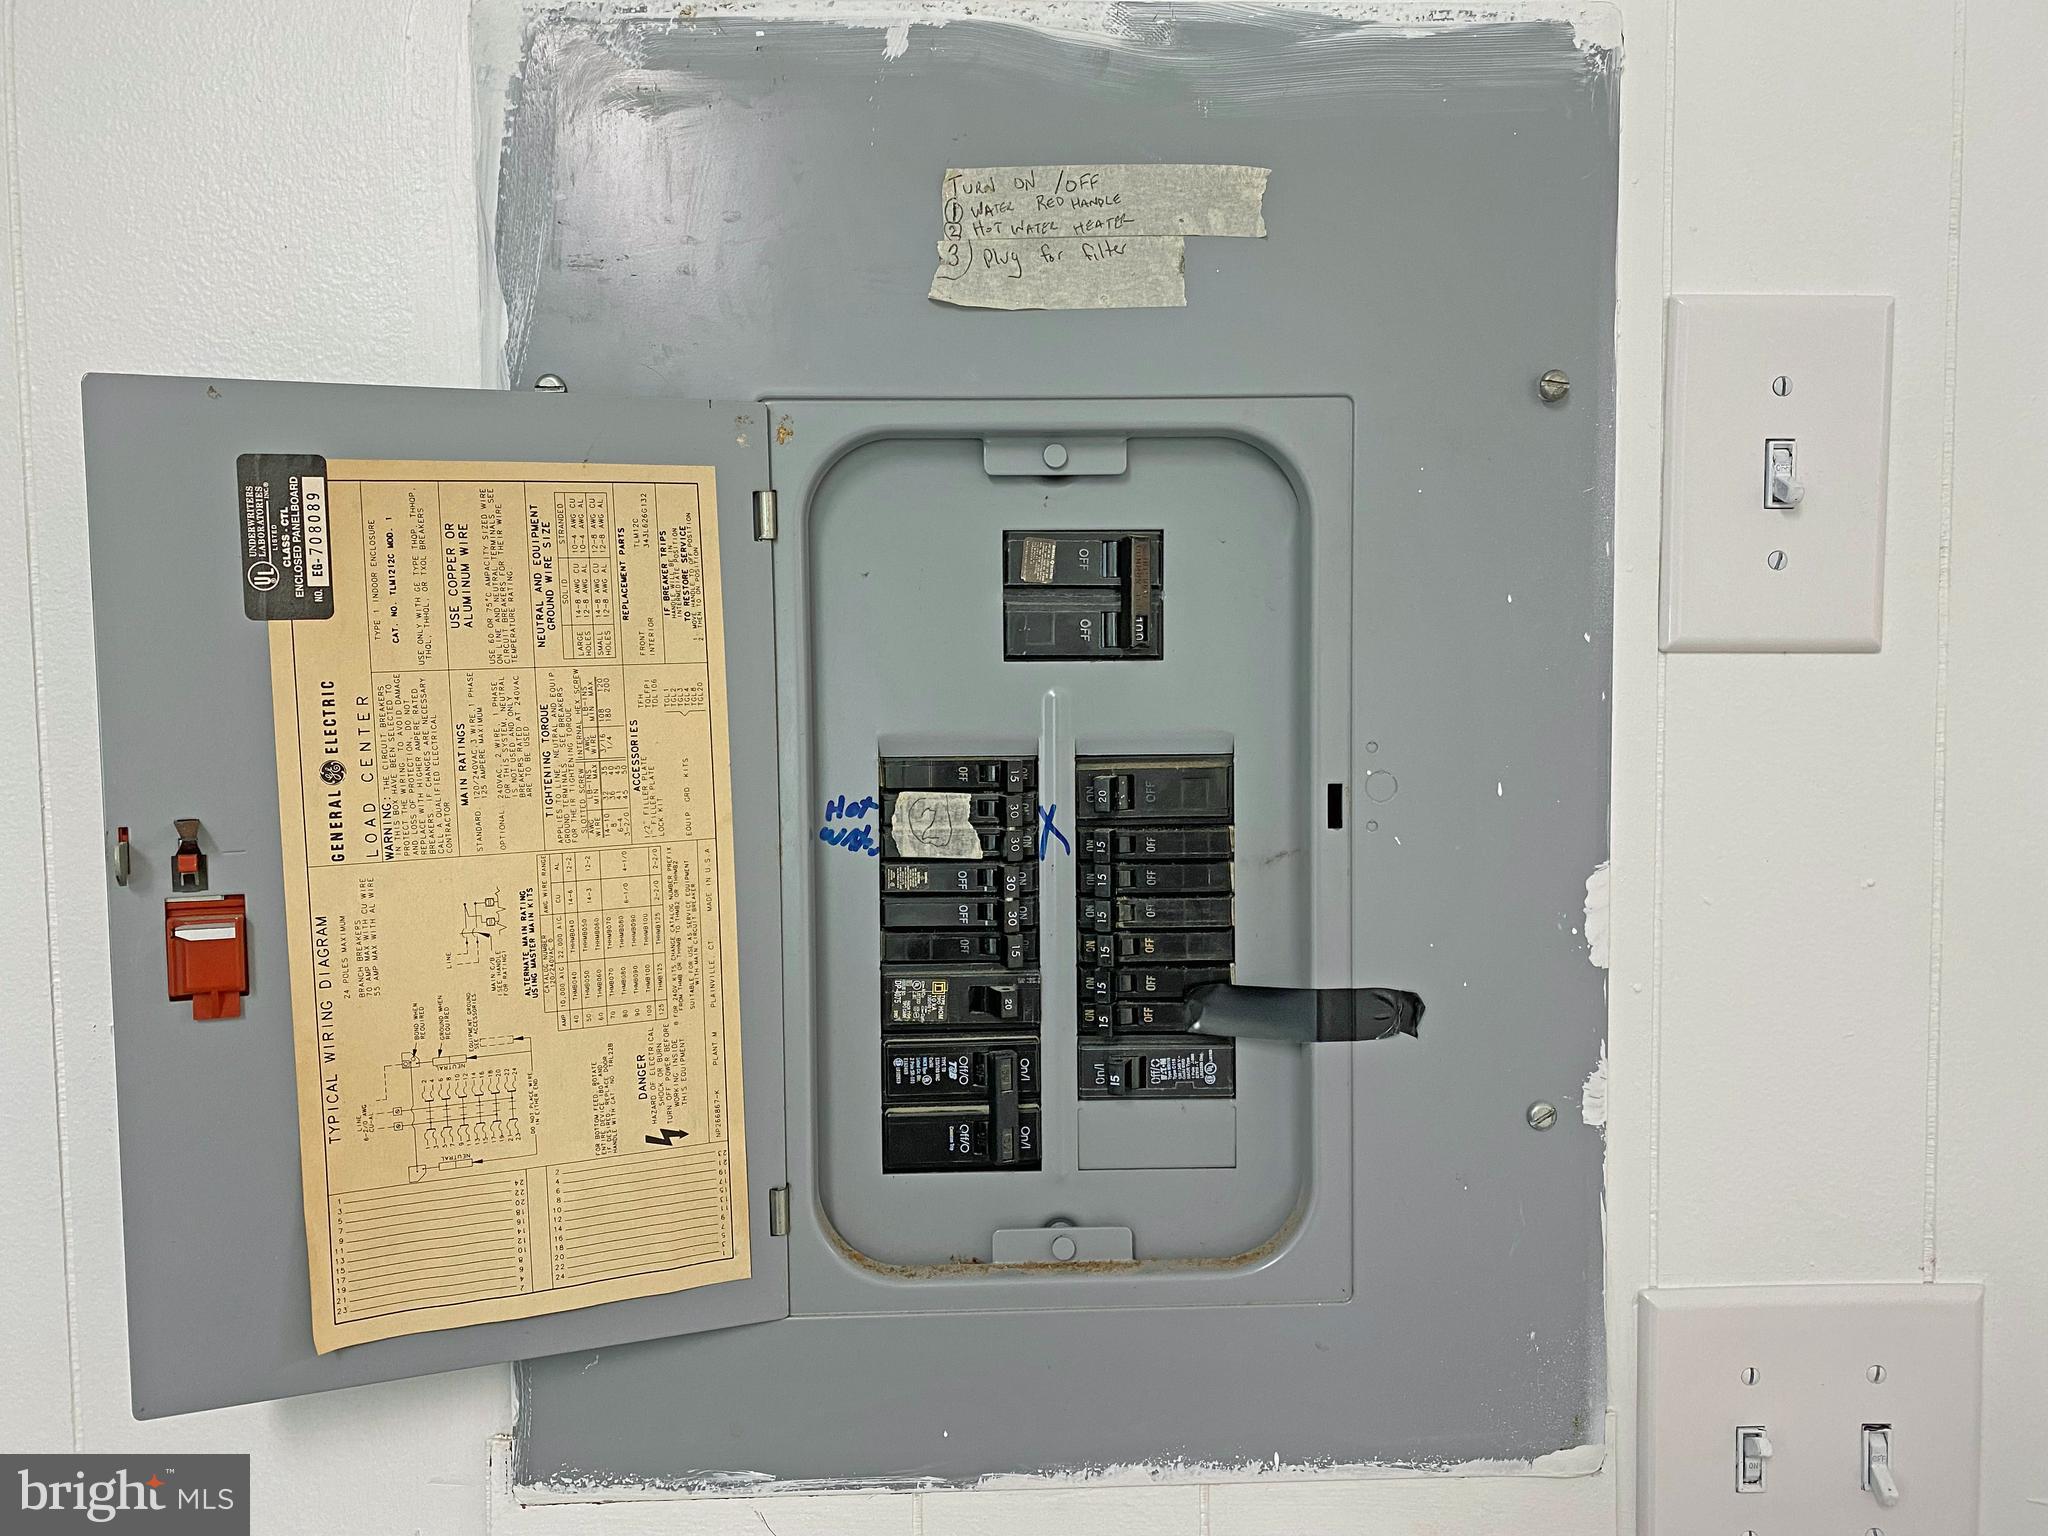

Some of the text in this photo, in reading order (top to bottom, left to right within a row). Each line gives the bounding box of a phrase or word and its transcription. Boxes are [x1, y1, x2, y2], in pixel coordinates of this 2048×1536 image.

[948, 174, 995, 198] TURN
[1014, 170, 1035, 190] ON
[1036, 194, 1065, 211] RED
[1070, 193, 1122, 210] HANDLE
[1010, 221, 1059, 235] WATER
[1040, 245, 1063, 263] for
[245, 485, 257, 557] UNDERWRITERS
[254, 486, 266, 557] LABORATORIES
[280, 506, 289, 526] CTL
[289, 476, 304, 597] ENCLOSED PANELBOARD
[367, 519, 377, 566] ENCLOSURE
[281, 534, 291, 567] CLASS
[1078, 548, 1089, 571] OFF
[387, 553, 397, 595] TLM1212C
[444, 522, 460, 628] USE COPPER OR
[457, 523, 473, 628] ALUMINUM WIRE
[529, 504, 546, 647] NEUTRAL AND EQUIPMENT
[540, 521, 556, 630] GROUND WIRE SIZE
[617, 527, 629, 621] REPLACEMENT PARTS
[659, 530, 671, 615] IF BREAKER TRIPS
[678, 525, 691, 622] TO RESTORE SERVICE
[314, 589, 323, 602] NO.
[370, 572, 379, 602] INDOOR
[390, 602, 398, 617] NO.
[373, 620, 381, 640] TYPE
[391, 623, 400, 643] CAT.
[647, 617, 655, 655] INTERIOR
[1079, 618, 1091, 642] OFF
[638, 631, 646, 655] FRONT
[455, 723, 469, 806] MAIN RATINGS
[629, 719, 641, 792] ACCESSORIES
[320, 680, 345, 862] GENERAL ELECTRIC
[356, 696, 379, 857] LOAD CENTER
[958, 766, 968, 781] OFF
[1010, 770, 1019, 782] 15
[542, 750, 554, 818] TIGHTENING
[1145, 781, 1155, 803] OFF
[1098, 790, 1107, 803] 20
[1009, 804, 1019, 818] 30
[381, 796, 395, 860] WARNING:
[1010, 837, 1020, 851] 30
[1096, 841, 1105, 853] 15
[1146, 836, 1156, 853] OFF
[958, 871, 968, 890] OFF
[1006, 876, 1016, 891] 30
[1019, 872, 1027, 885] ON
[1097, 874, 1106, 886] 15
[1146, 870, 1156, 886] OFF
[519, 890, 527, 921] RATING
[959, 905, 968, 924] OFF
[1019, 906, 1027, 920] ON
[1008, 911, 1017, 926] 30
[1097, 911, 1106, 923] 15
[526, 887, 539, 998] USING MASTER MAIN KITS
[960, 940, 970, 954] OFF
[1011, 945, 1020, 957] 15
[1101, 946, 1110, 958] 15
[1144, 937, 1154, 953] OFF
[339, 915, 351, 999] 24 POLES MAXIMUM
[354, 919, 366, 998] BRANCH BREAKERS
[522, 951, 531, 996] ALTERNATE
[1146, 975, 1156, 991] OFF
[1097, 982, 1106, 994] 15
[1004, 998, 1012, 1010] 20
[1143, 1007, 1153, 1022] OFF
[314, 915, 342, 1144] TYPICAL WIRING DIAGRAM
[1099, 1016, 1108, 1028] 15
[636, 1054, 648, 1100] DANGER
[647, 1026, 658, 1124] HAZARD OF ELECTRICAL
[1110, 1075, 1120, 1086] 15
